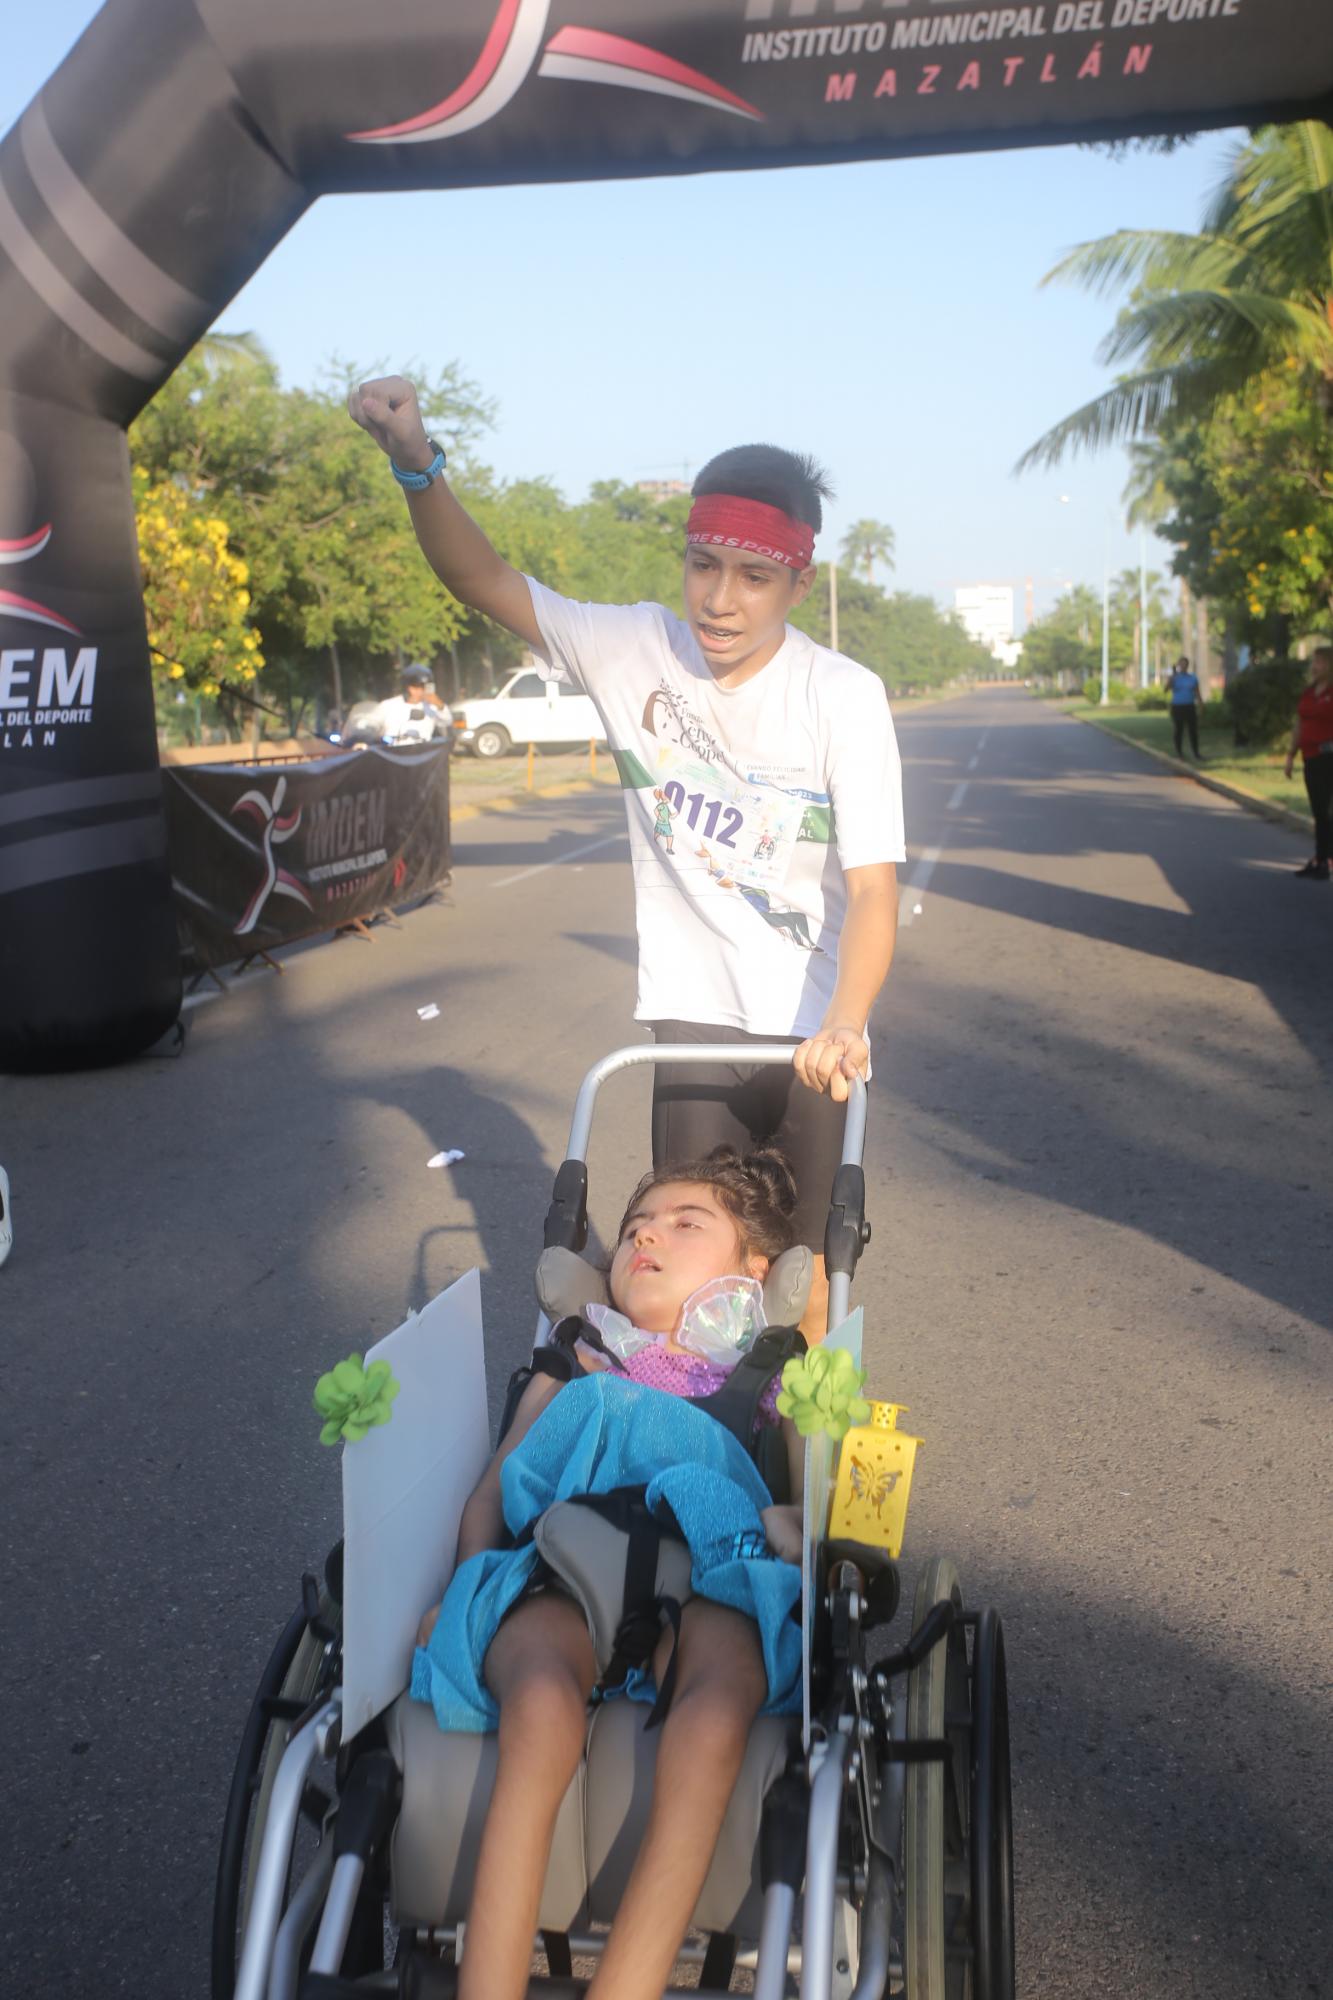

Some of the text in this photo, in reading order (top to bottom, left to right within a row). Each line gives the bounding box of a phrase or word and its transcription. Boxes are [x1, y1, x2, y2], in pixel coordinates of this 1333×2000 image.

[742, 22, 887, 62] INSTITUTO
[891, 8, 1047, 50] MUNICIPAL
[1053, 0, 1105, 33] DEL
[825, 40, 1153, 102] MAZATLÁN
[7, 711, 32, 726] DEL
[35, 708, 92, 725] DEPORTE
[305, 788, 387, 865] IMDEM
[664, 780, 744, 849] 0112
